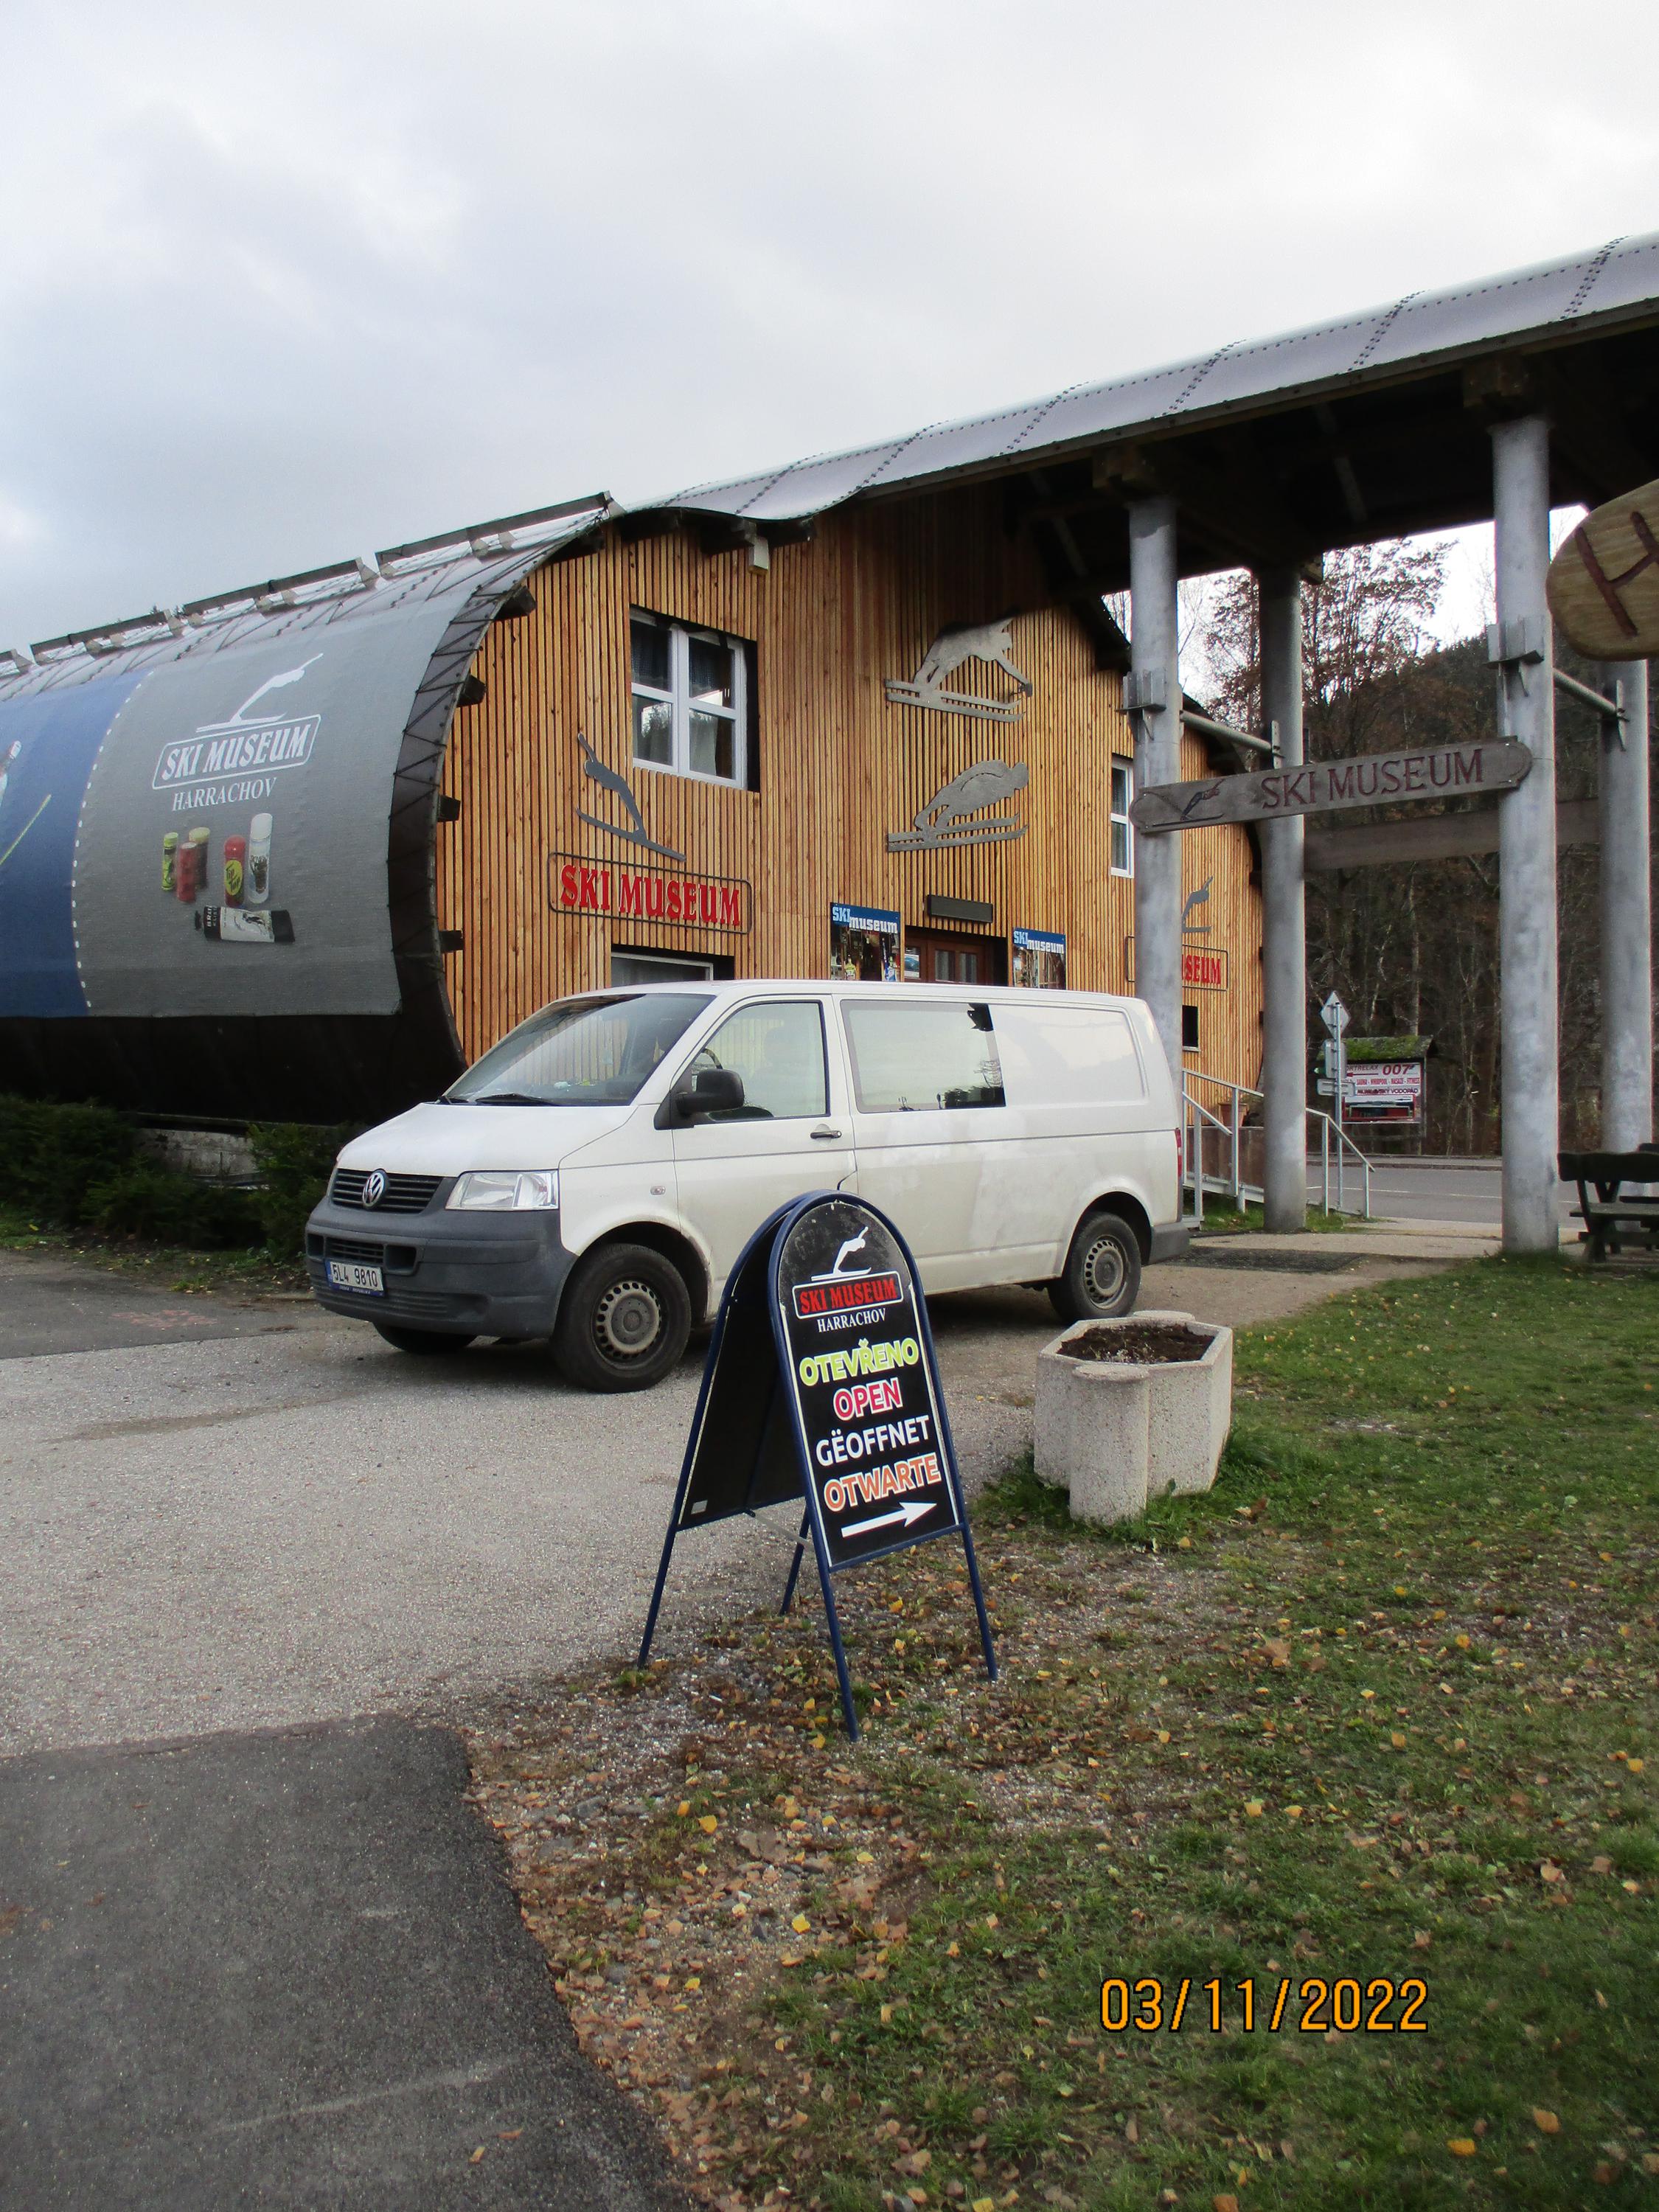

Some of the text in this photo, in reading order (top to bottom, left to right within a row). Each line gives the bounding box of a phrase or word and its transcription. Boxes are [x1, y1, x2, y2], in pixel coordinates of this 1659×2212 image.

[161, 724, 311, 781] SKI MUSEUM
[172, 777, 277, 811] HARRACHOV
[1261, 748, 1484, 809] SKI MUSEUM
[559, 864, 740, 927] SKI MUSEUM
[832, 906, 898, 934] SKI museum
[1013, 931, 1065, 954] SKI museum
[1182, 954, 1221, 985] SEUM
[1382, 1064, 1411, 1076] 007
[333, 1264, 378, 1287] 5L4 9810
[799, 1278, 898, 1314] SKI MUSEUM
[817, 1308, 886, 1333] HARRACHOV
[799, 1338, 919, 1386] OTEVŘENO
[833, 1377, 903, 1421] OPEN
[815, 1415, 930, 1467] GËOFFNET
[824, 1452, 942, 1512] OTWARTE
